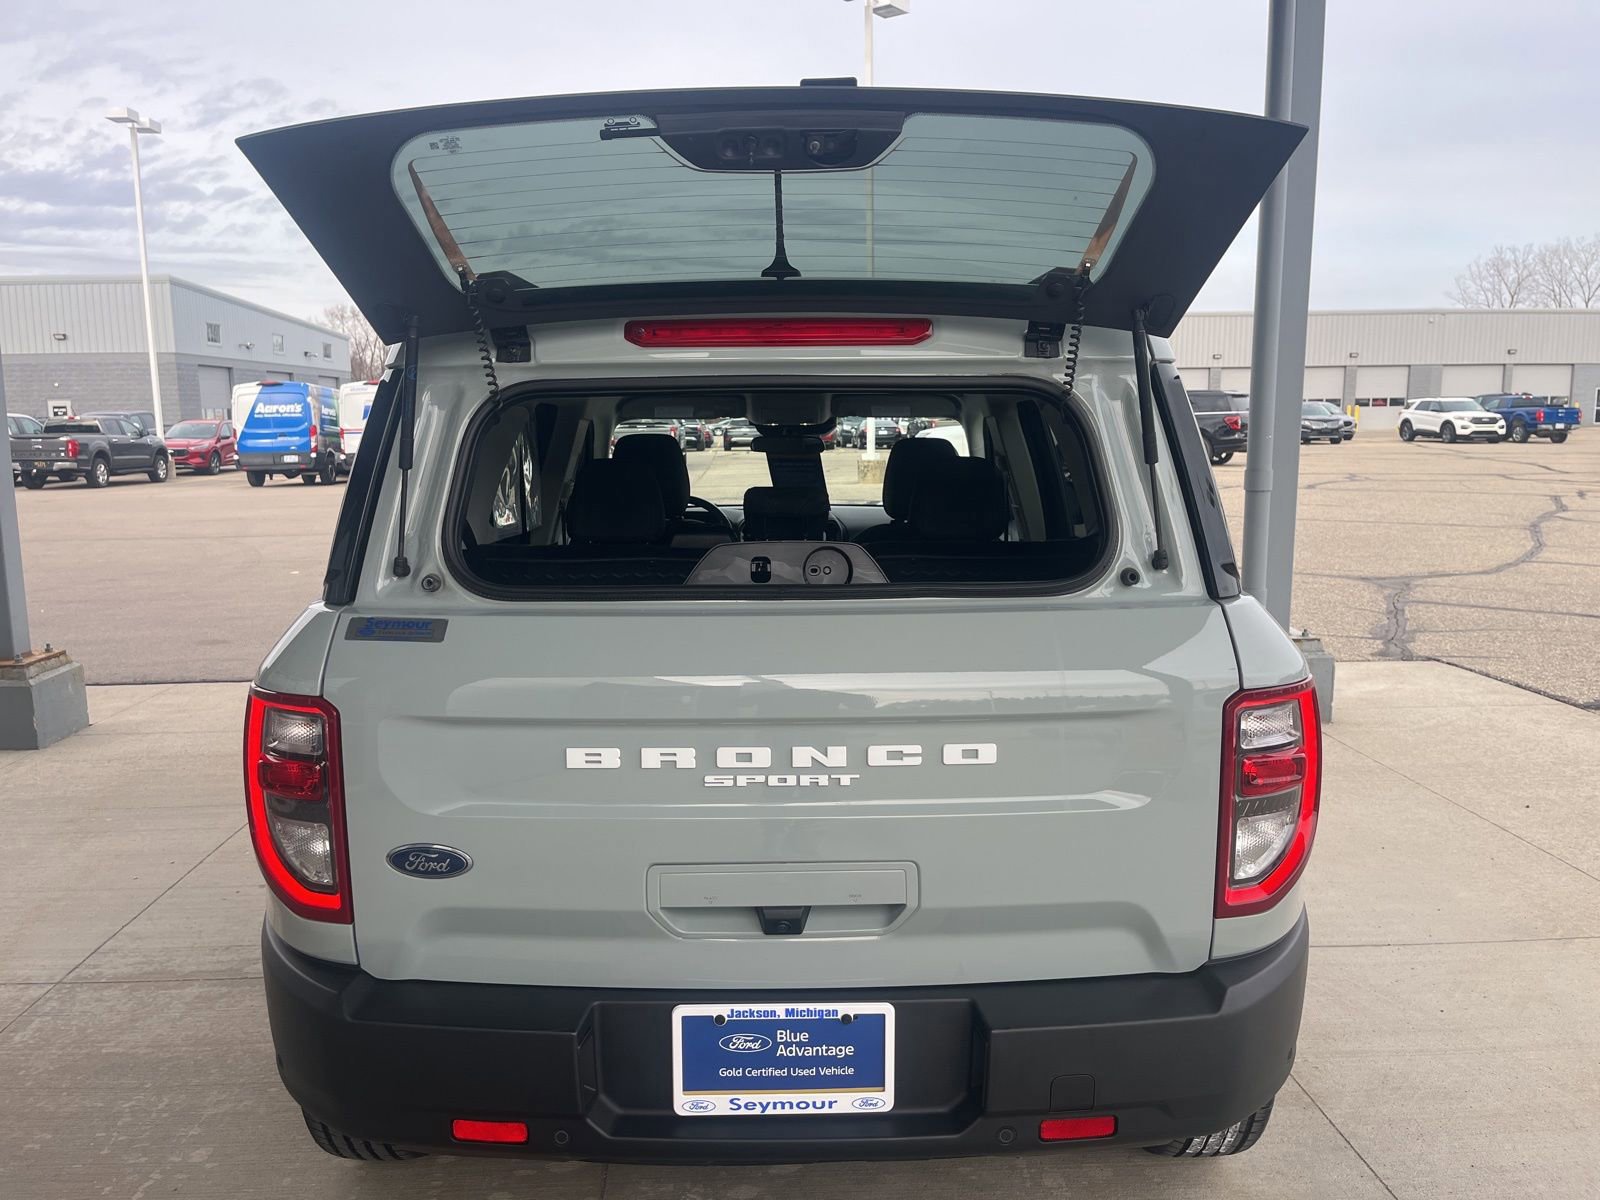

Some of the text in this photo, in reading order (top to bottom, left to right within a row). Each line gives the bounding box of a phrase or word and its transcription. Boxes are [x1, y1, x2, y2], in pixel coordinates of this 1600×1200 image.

[254, 402, 304, 414] Aaron's
[366, 616, 434, 630] Seymour
[565, 743, 998, 769] BRONCO
[703, 774, 860, 788] SPORT
[404, 851, 451, 872] Ford
[726, 1007, 839, 1020] Jackson, Michigan
[728, 1033, 762, 1051] Ford
[776, 1030, 809, 1043] Blue
[776, 1044, 855, 1058] Advantage
[719, 1065, 855, 1077] Gold Certified Used Vehicle
[729, 1097, 838, 1114] Seymour
